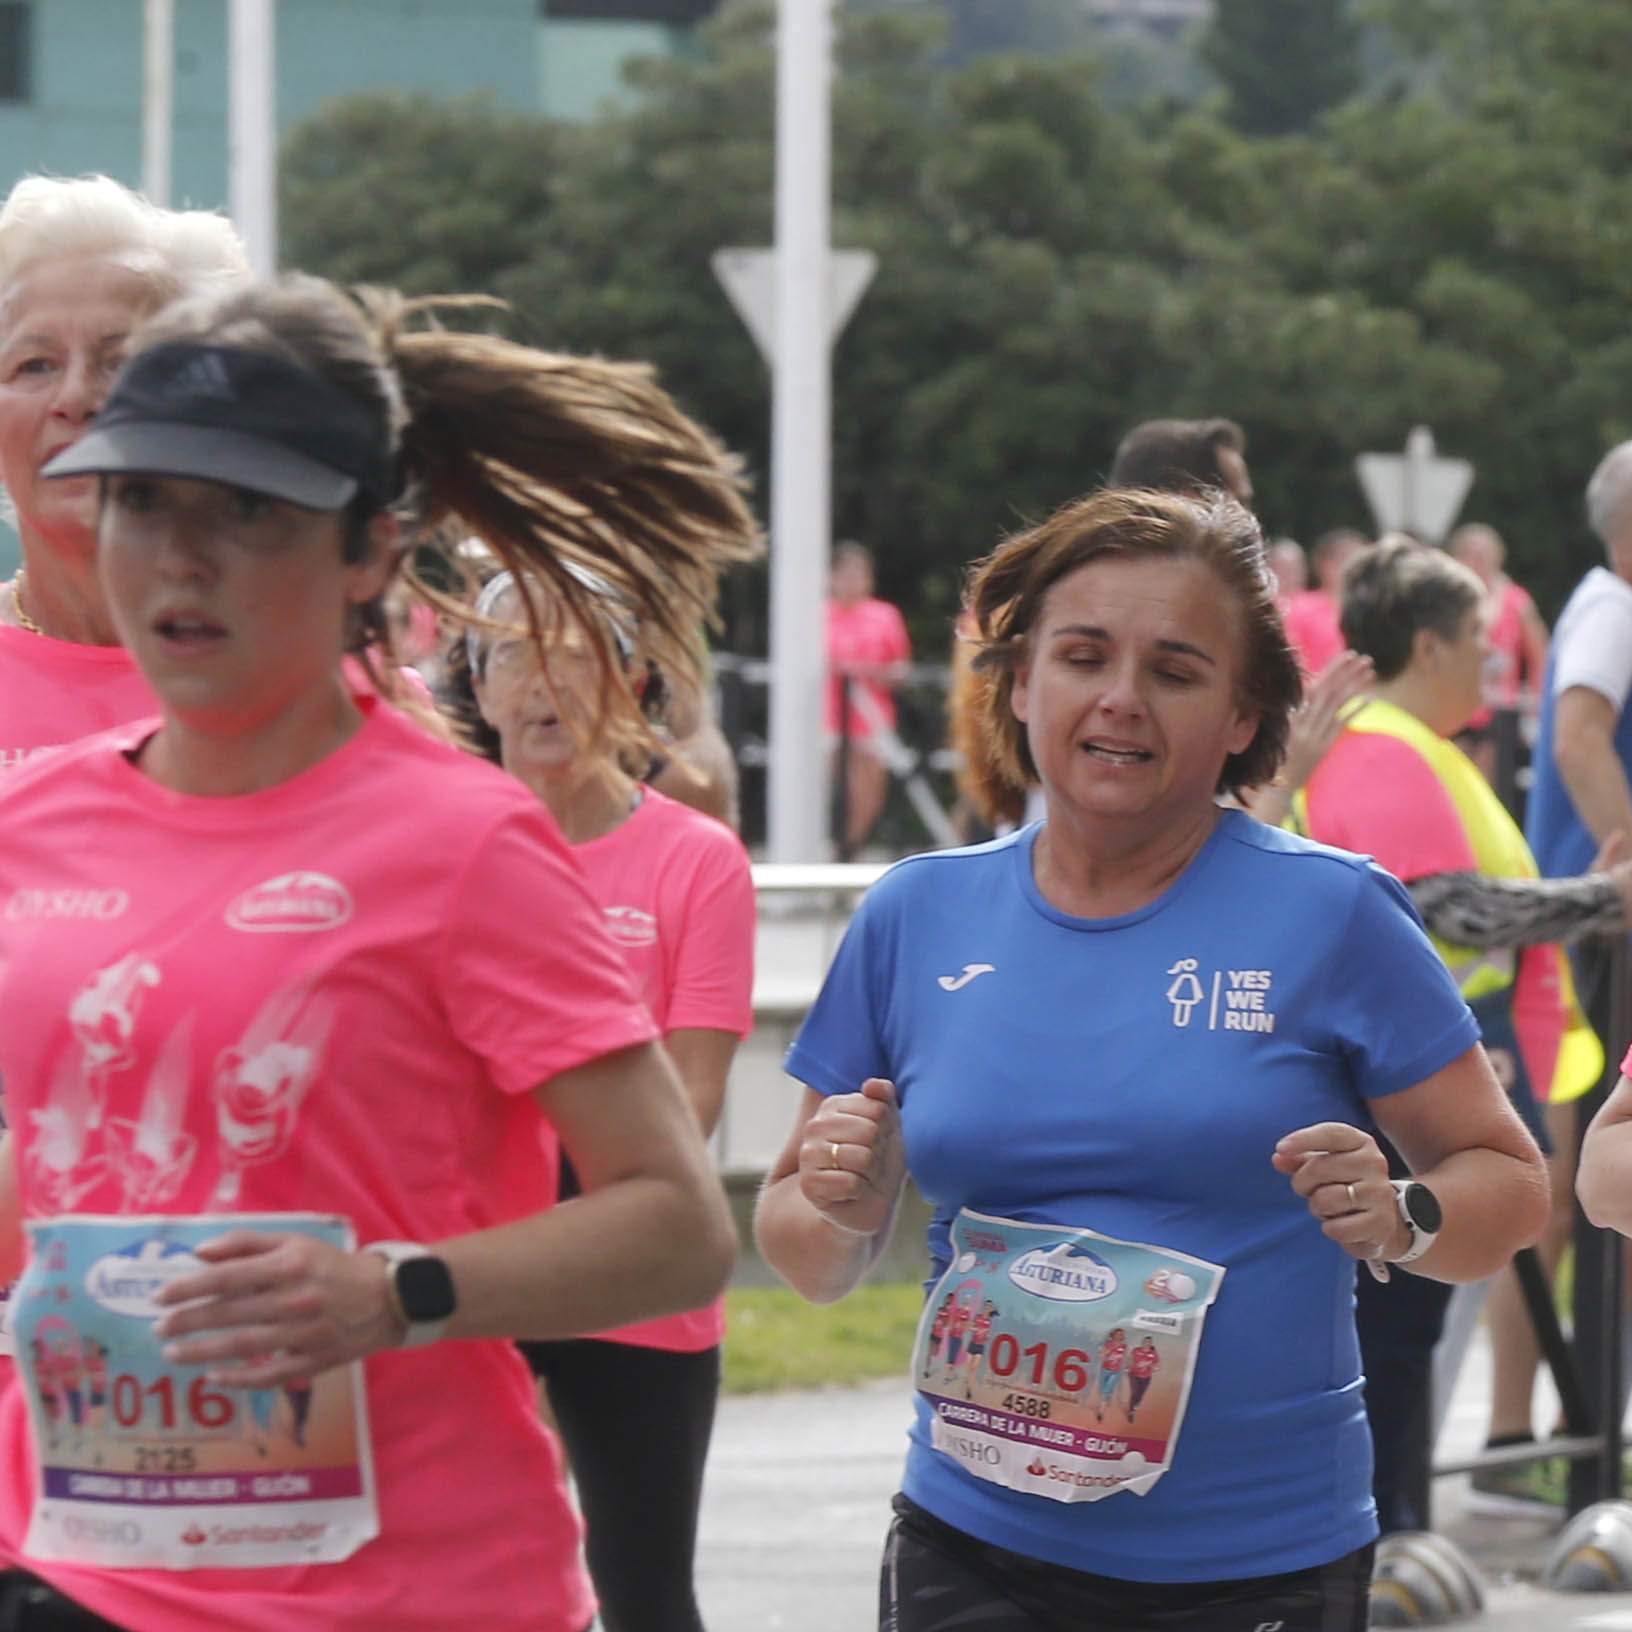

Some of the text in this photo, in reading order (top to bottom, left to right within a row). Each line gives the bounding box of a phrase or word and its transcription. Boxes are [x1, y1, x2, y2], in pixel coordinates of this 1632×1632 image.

[1227, 969, 1273, 990] YES
[1225, 990, 1265, 1011] WE
[1224, 1010, 1275, 1033] RUN
[990, 1333, 1089, 1391] 016
[113, 1374, 235, 1429] 016
[1002, 1393, 1051, 1419] 4588
[937, 1402, 989, 1428] CARRERA
[990, 1415, 1007, 1432] DE
[1007, 1420, 1026, 1437] LA
[1028, 1424, 1075, 1447] MUJER
